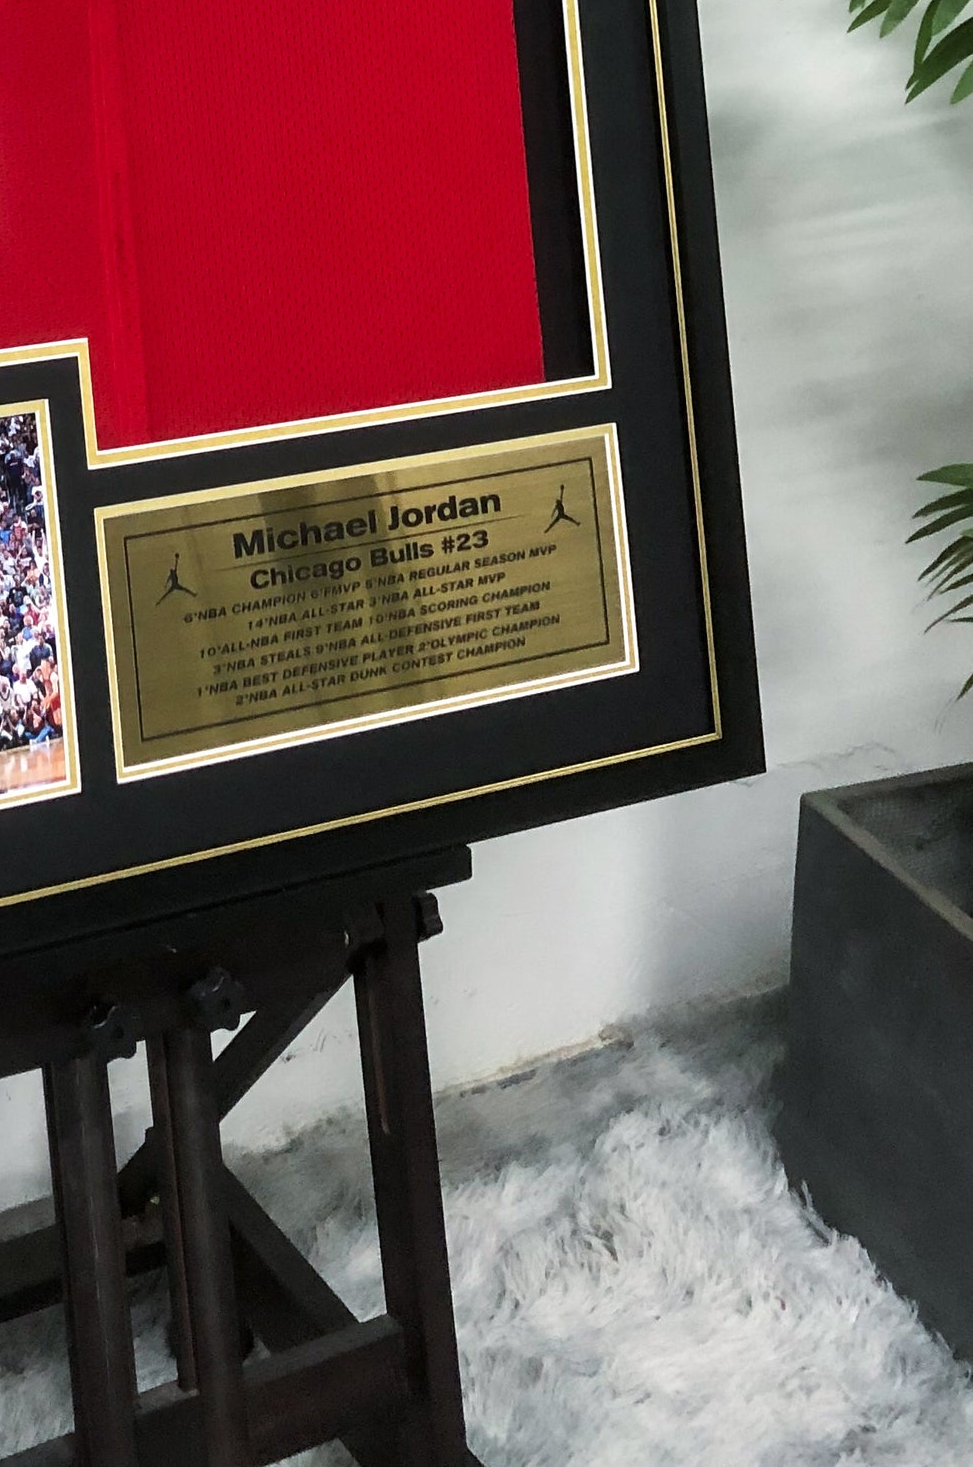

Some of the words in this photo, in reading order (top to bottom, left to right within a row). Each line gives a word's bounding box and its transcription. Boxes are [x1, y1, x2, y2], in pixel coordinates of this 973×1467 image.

[233, 509, 377, 559] Michael
[388, 493, 501, 531] Jordan
[231, 591, 307, 615] CHAMPION
[409, 562, 470, 582] REGULAR
[474, 549, 526, 569] SEASON
[528, 544, 558, 559] MVP
[250, 557, 362, 590] Chicago
[370, 541, 435, 568] Bulls
[441, 529, 489, 554] #23
[413, 578, 474, 600] ALL-STAR
[477, 572, 506, 587] MVP
[260, 645, 311, 666] STEALS
[465, 608, 501, 625] FIRST
[505, 600, 540, 616] TEAM
[283, 626, 322, 642] FIRST
[327, 617, 363, 634] TEAM
[420, 595, 478, 615] SCORING
[482, 581, 551, 603] CHAMPION
[243, 671, 279, 687] BEST
[282, 655, 359, 679] DEFENSIVE
[362, 644, 414, 664] PLAYER
[492, 613, 561, 637] CHAMPION
[282, 673, 346, 696] ALL-STAR
[350, 666, 387, 683] DUNK
[391, 651, 453, 672] CONTEST
[457, 637, 526, 660] CHAMPION
